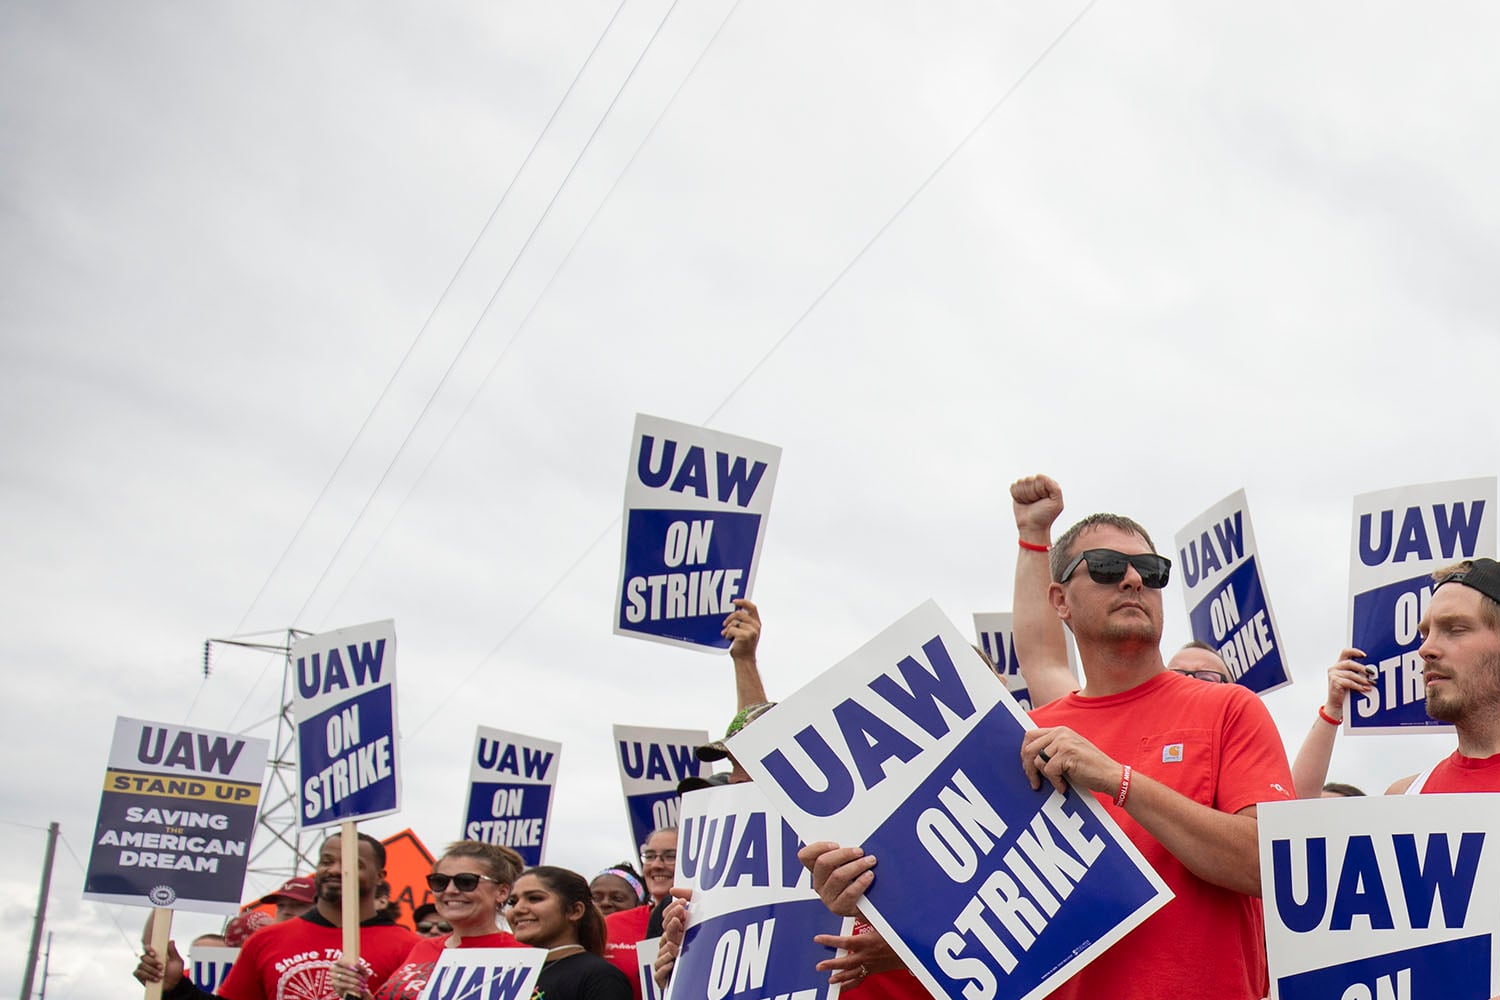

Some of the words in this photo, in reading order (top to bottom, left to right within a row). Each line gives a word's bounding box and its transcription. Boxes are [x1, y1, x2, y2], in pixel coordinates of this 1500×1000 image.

[638, 434, 768, 508] UAW
[664, 519, 714, 568] ON
[1180, 510, 1245, 589] UAW
[1358, 500, 1486, 567] UAW
[625, 569, 743, 624] STRIKE
[1210, 582, 1240, 643] ON
[297, 638, 386, 699] UAW
[1217, 608, 1274, 683] RIKE
[1357, 650, 1426, 718] STR
[137, 726, 246, 775] UAW
[326, 703, 360, 754] ON
[760, 634, 978, 818] UAW
[304, 742, 392, 819] STRIKE
[477, 737, 554, 781] UAW
[620, 741, 701, 784] UAW
[113, 776, 206, 797] STAND
[215, 785, 251, 800] UP
[491, 788, 524, 818] ON
[98, 830, 246, 857] AMERICAN
[125, 807, 229, 830] SAVING
[465, 818, 543, 847] STRIKE
[916, 769, 1002, 884] ON
[119, 851, 219, 873] DREAM
[1272, 832, 1485, 934] UAW
[275, 950, 320, 973] Share
[324, 948, 343, 960] Th
